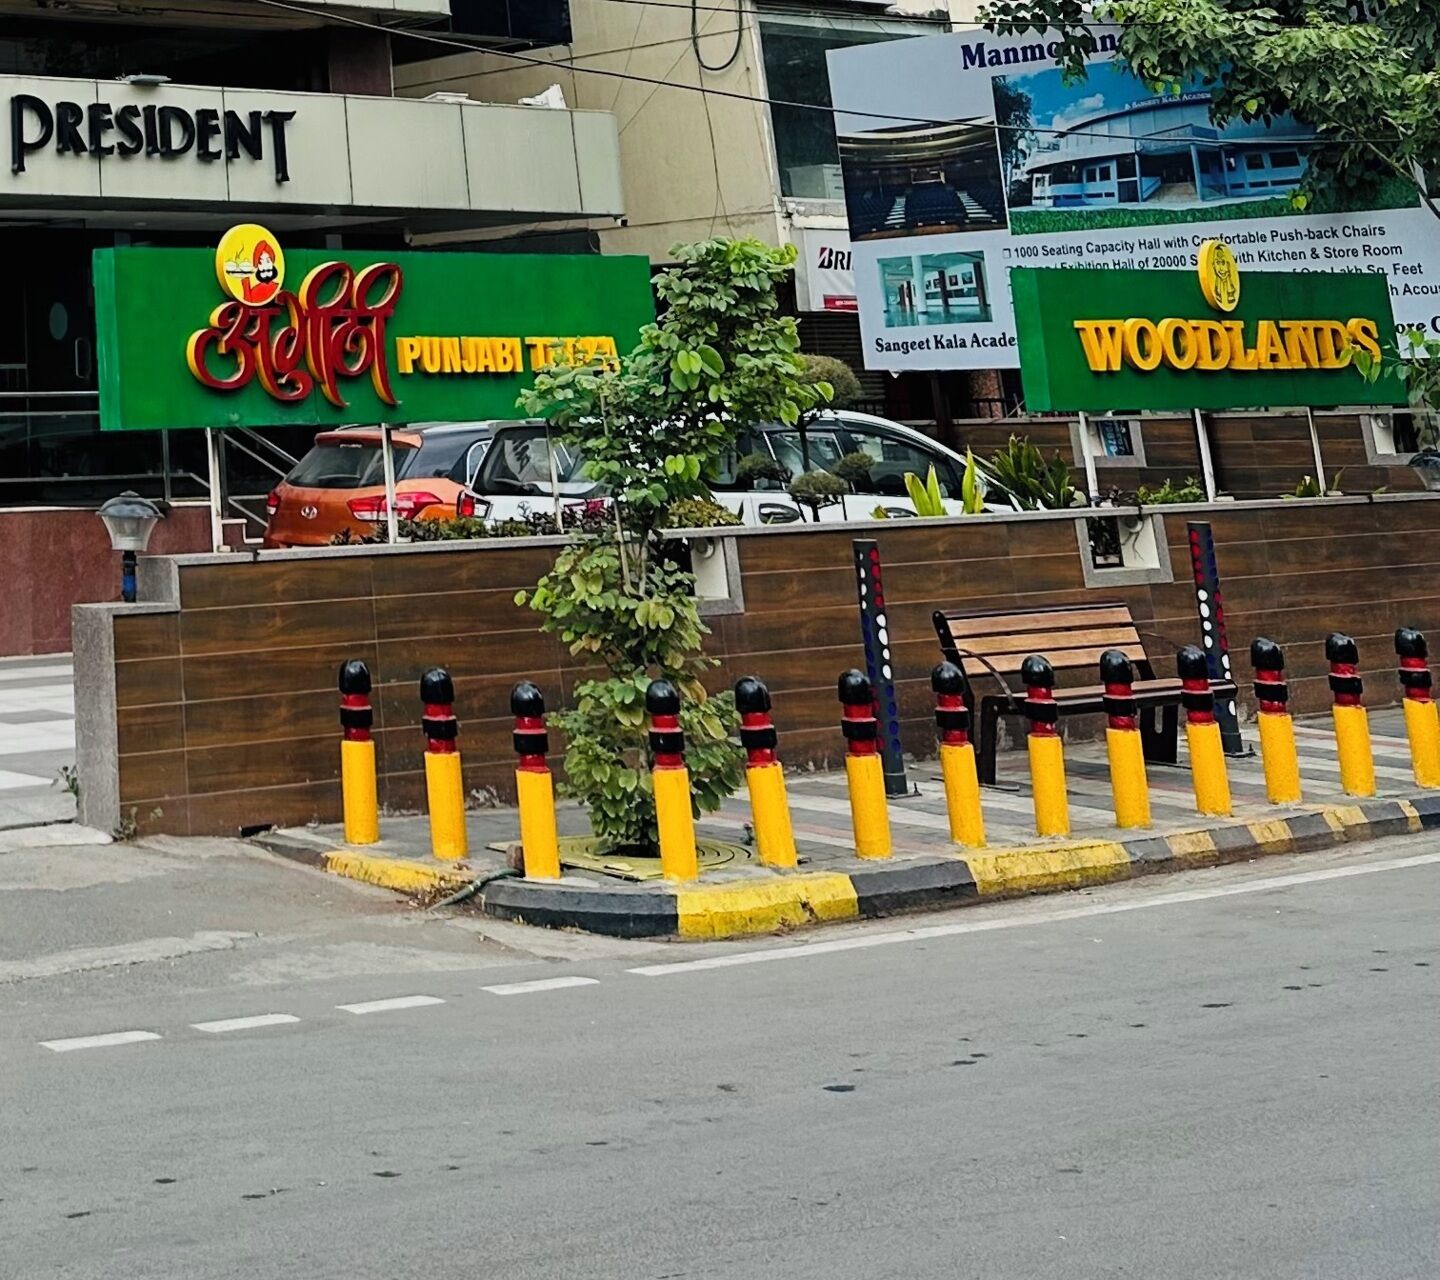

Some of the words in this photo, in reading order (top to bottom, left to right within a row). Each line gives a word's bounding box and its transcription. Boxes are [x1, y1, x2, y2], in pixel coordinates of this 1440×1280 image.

[960, 32, 1119, 71] Manmoan
[10, 93, 297, 183] PRESIDENT
[1014, 245, 1039, 259] 1000
[1041, 243, 1084, 257] Seating
[1086, 240, 1135, 256] Capacity
[1138, 238, 1161, 251] Hall
[1164, 235, 1189, 249] with
[1270, 226, 1339, 242] Push-back
[1342, 224, 1386, 238] Chairs
[1112, 258, 1135, 270] Hall
[1137, 256, 1150, 270] of
[1152, 254, 1187, 268] 20000
[1257, 249, 1306, 264] Kitchen
[1309, 247, 1321, 260] &
[1323, 245, 1359, 260] Store
[1362, 243, 1403, 257] Room
[1392, 261, 1424, 276] Feet
[396, 335, 524, 374] PUNJABI
[874, 336, 931, 355] Sangeet
[933, 333, 967, 351] Kala
[1073, 317, 1383, 372] WOODLANDS
